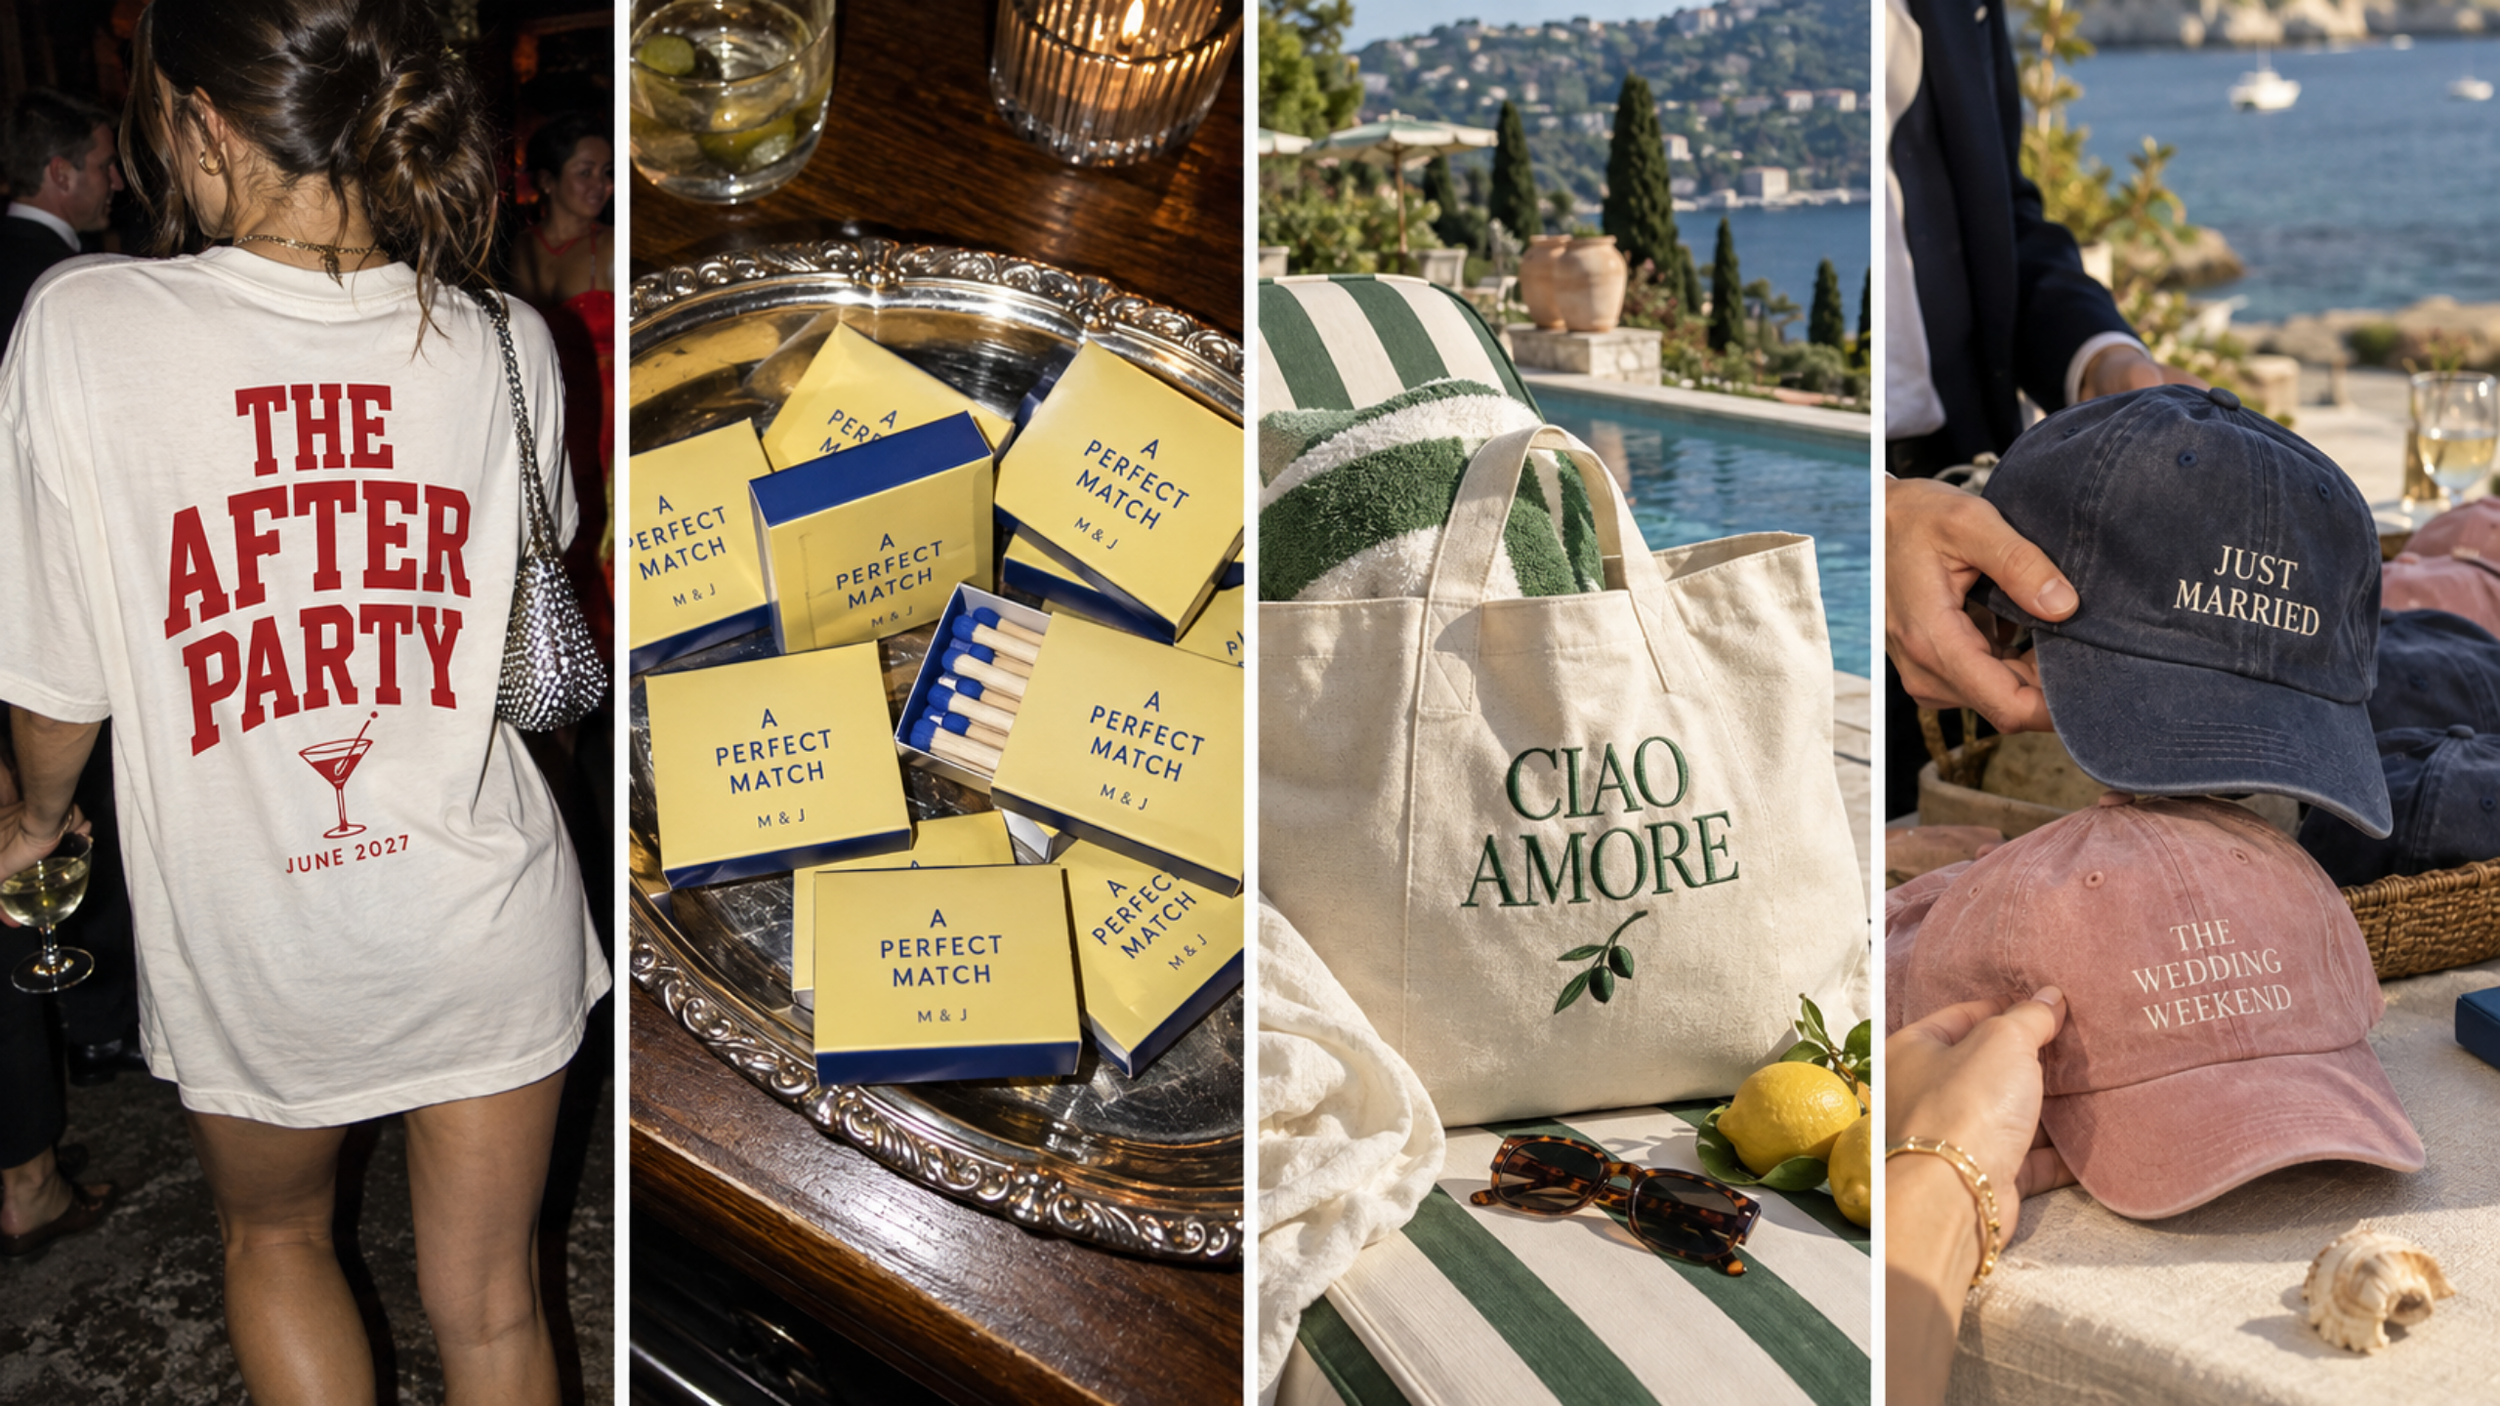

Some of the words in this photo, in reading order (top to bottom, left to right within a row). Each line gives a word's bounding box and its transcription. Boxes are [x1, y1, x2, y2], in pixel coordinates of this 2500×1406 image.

[235, 383, 394, 477] THE
[879, 409, 898, 430] A
[1139, 439, 1160, 460] A
[1083, 439, 1190, 509] PERFECT
[658, 494, 674, 516] A
[1075, 469, 1161, 530] MATCH
[879, 533, 895, 552] A
[1074, 517, 1091, 533] M
[1091, 528, 1104, 543] &
[1106, 538, 1119, 550] J
[164, 479, 472, 640] AFTER
[639, 536, 726, 581] MATCH
[836, 540, 943, 590] PERFECT
[2213, 544, 2299, 591] JUST
[672, 593, 687, 607] M
[692, 588, 703, 601] &
[709, 583, 716, 596] J
[848, 567, 932, 609] MATCH
[871, 615, 884, 628] M
[890, 611, 899, 622] &
[906, 605, 913, 616] J
[2173, 578, 2321, 637] MARRIED
[182, 603, 464, 757] PARTY
[761, 708, 778, 729] A
[1143, 690, 1160, 712] A
[715, 729, 831, 767] PERFECT
[1089, 704, 1205, 756] PERFECT
[730, 760, 824, 794] MATCH
[1090, 736, 1183, 782] MATCH
[1099, 783, 1116, 800] M
[1120, 791, 1132, 805] &
[1138, 798, 1148, 811] J
[1505, 736, 1689, 822] CIAO
[757, 815, 772, 828] M
[779, 811, 790, 825] &
[798, 808, 805, 822] J
[285, 847, 344, 874] JUNE
[355, 834, 410, 861] 2027
[1460, 809, 1740, 908] AMORE
[1106, 879, 1128, 898] A
[929, 908, 947, 928] A
[1091, 874, 1180, 946] PERFEC
[1120, 890, 1197, 960] MATCH
[880, 934, 1003, 959] PERFECT
[1168, 955, 1185, 971] M
[1183, 945, 1197, 957] &
[1197, 933, 1207, 946] J
[2169, 918, 2236, 952] THE
[893, 964, 991, 988] MATCH
[2131, 947, 2282, 995] WEDDING
[917, 1009, 932, 1023] M
[939, 1008, 951, 1022] &
[960, 1008, 967, 1022] J
[2142, 983, 2293, 1031] WEEKEND
